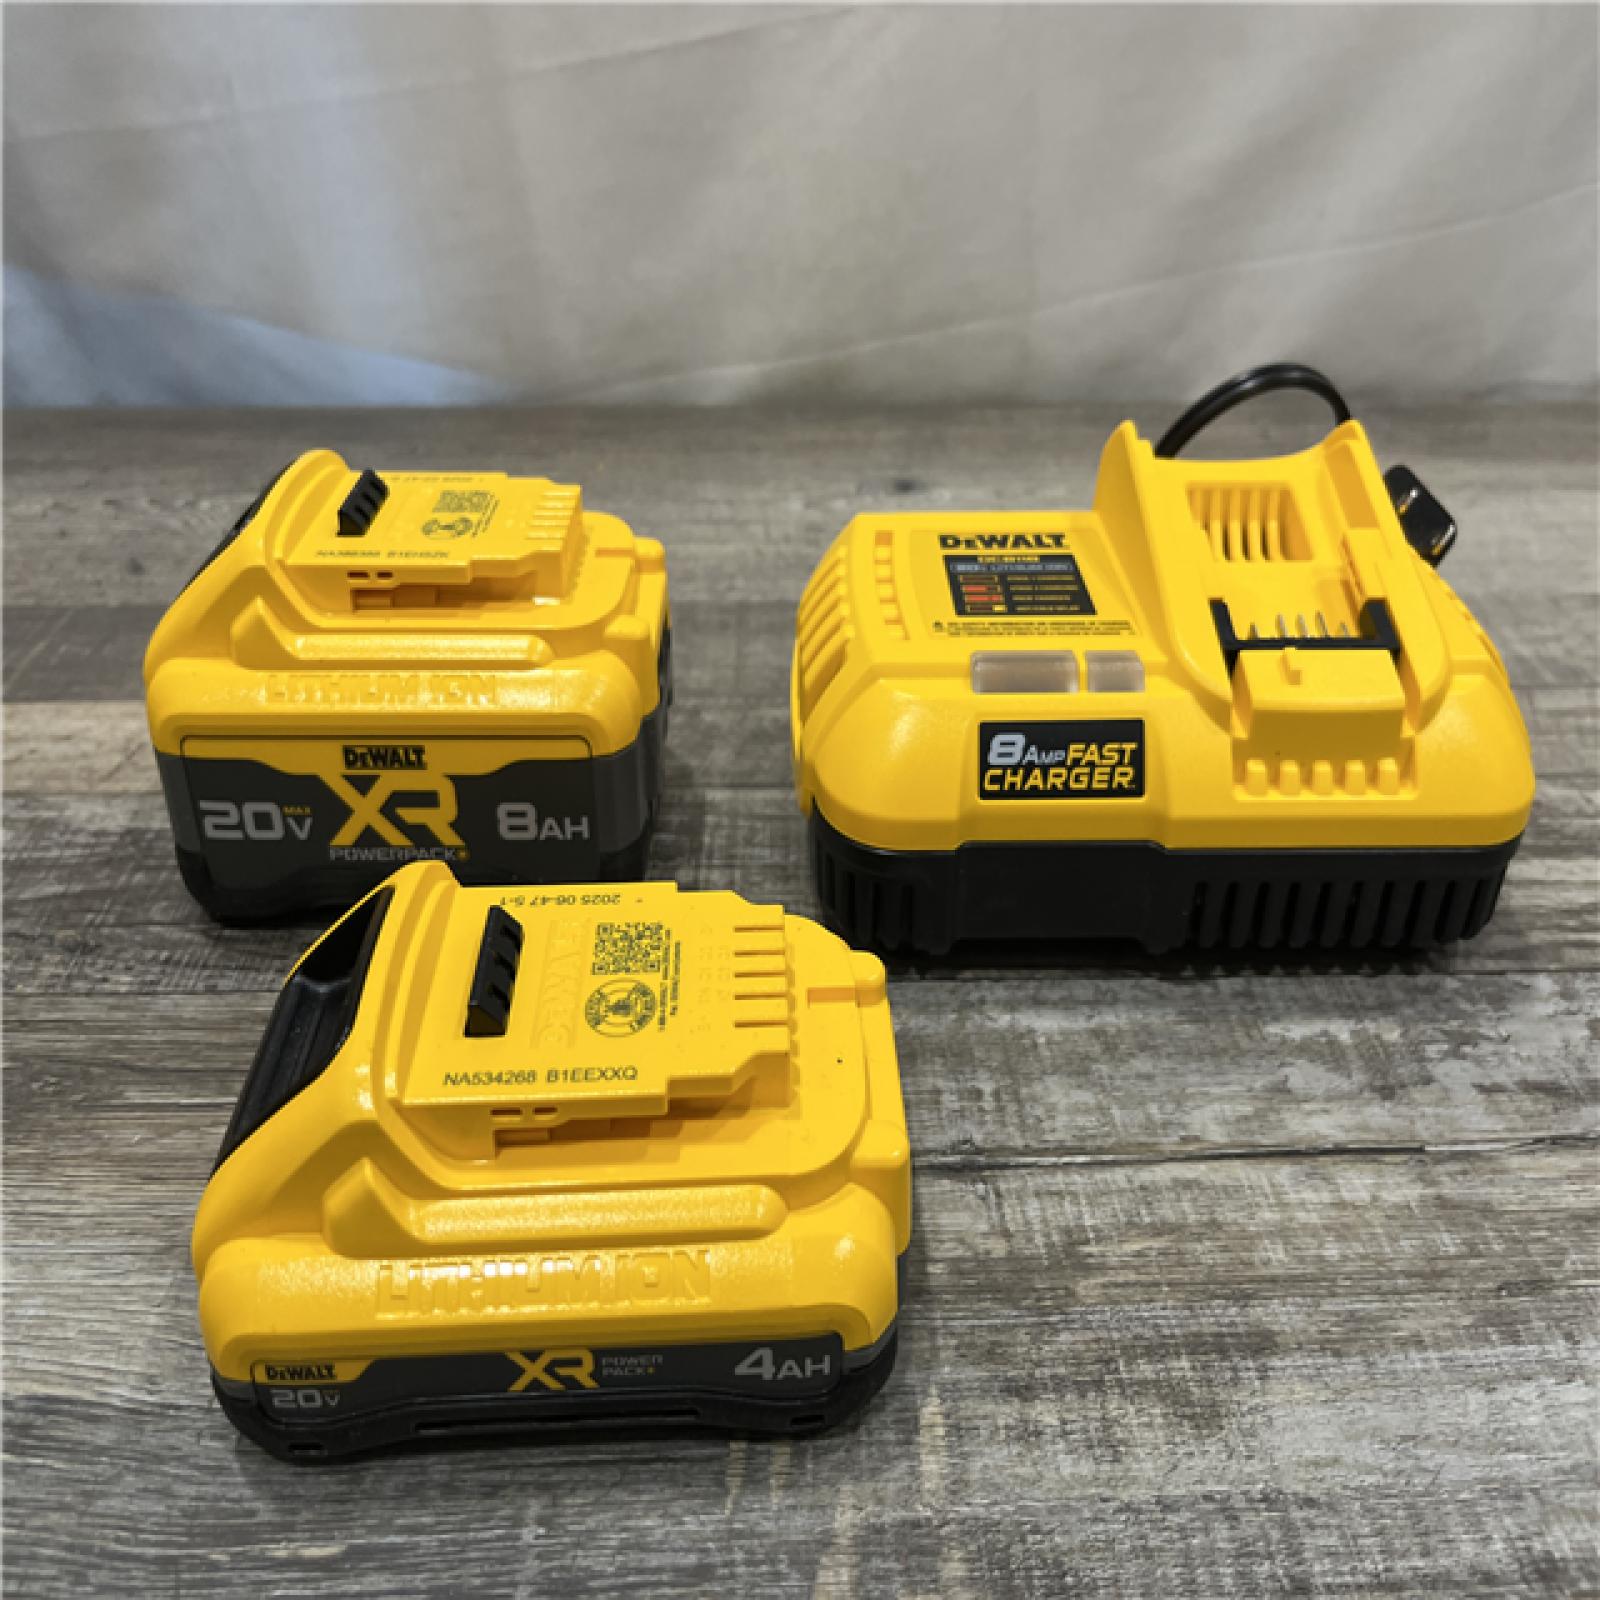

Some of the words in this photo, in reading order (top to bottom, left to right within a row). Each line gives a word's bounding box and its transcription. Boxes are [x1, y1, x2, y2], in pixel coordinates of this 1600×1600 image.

[938, 533, 1066, 550] DEWALT
[343, 745, 427, 770] DEWALT
[1065, 742, 1138, 766] FAST
[984, 767, 1136, 791] CHARGER
[318, 771, 467, 847] XR
[264, 1364, 337, 1381] DEWALT
[507, 1350, 600, 1392] XR
